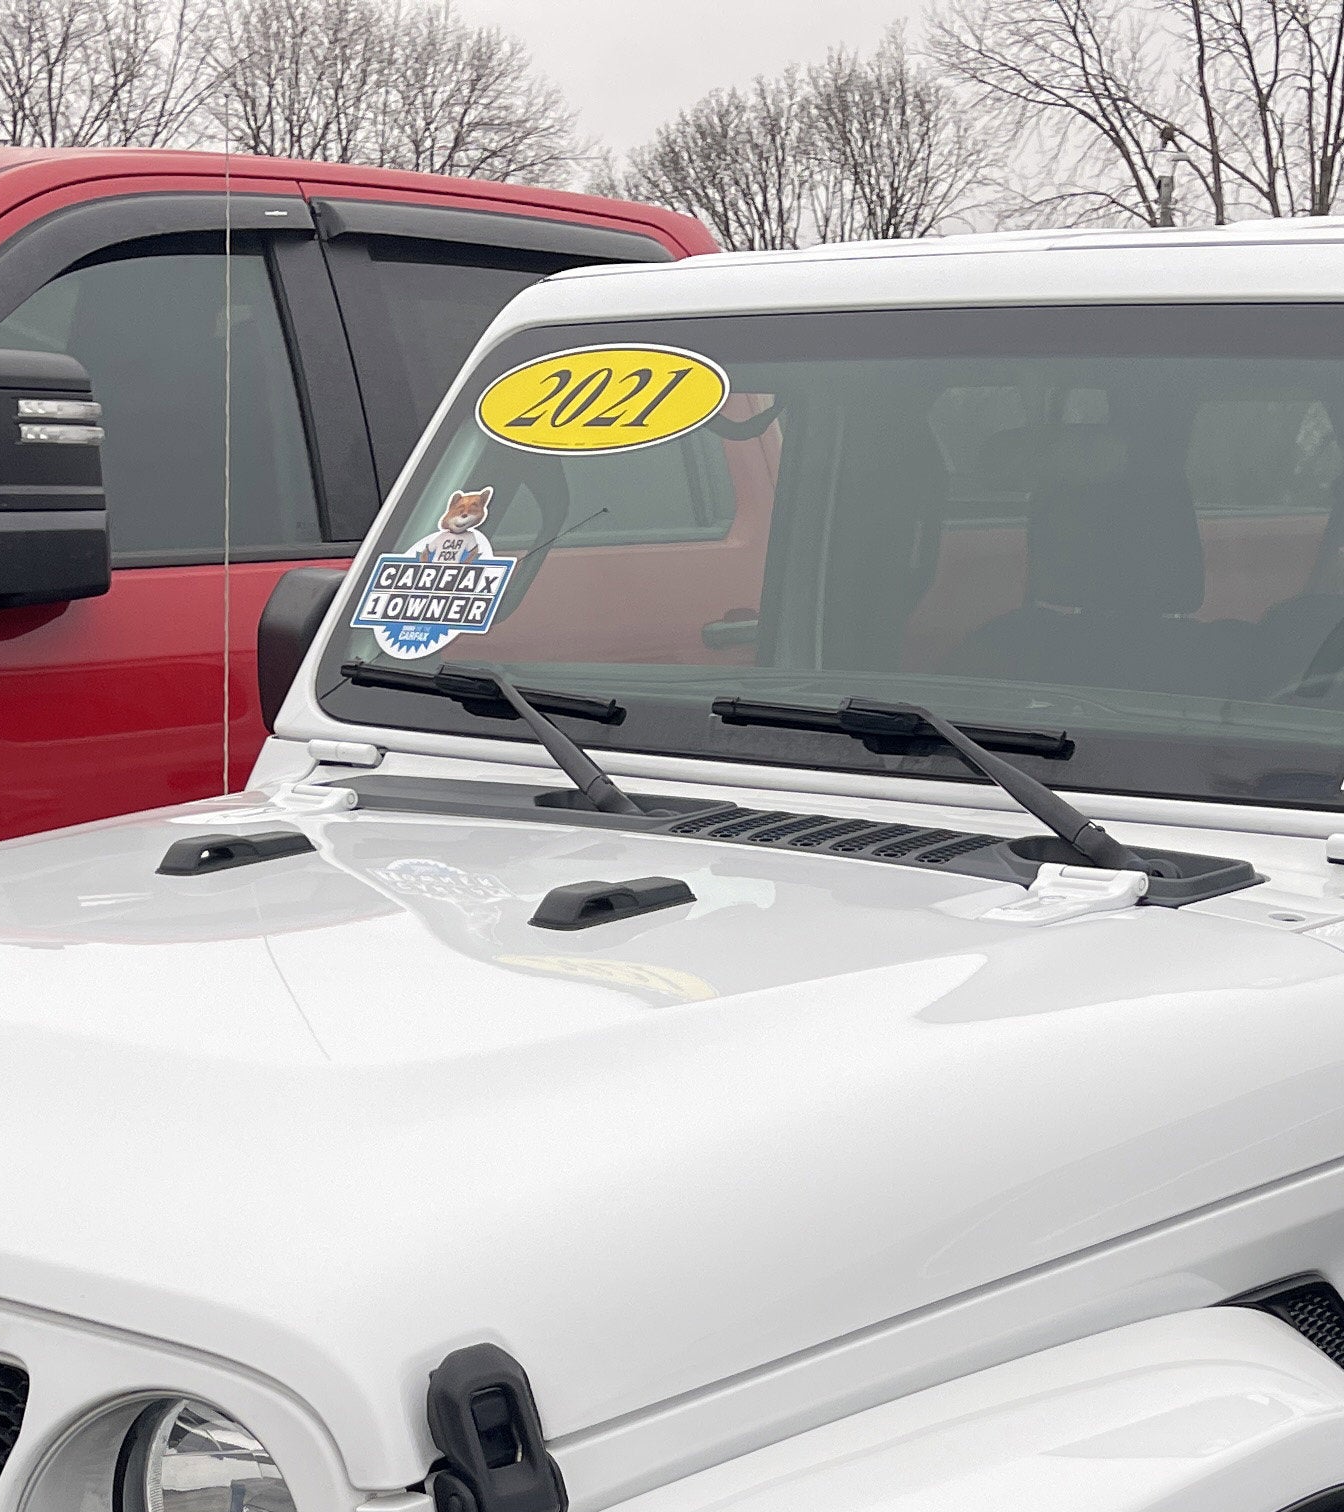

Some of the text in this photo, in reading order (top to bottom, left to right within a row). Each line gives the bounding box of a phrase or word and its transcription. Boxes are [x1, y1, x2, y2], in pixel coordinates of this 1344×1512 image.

[504, 367, 694, 428] 2021
[442, 539, 463, 550] CAR
[437, 551, 458, 562] FOX
[379, 566, 499, 594] CARFAX
[367, 595, 487, 621] 1 OWNER
[398, 631, 430, 642] CARFAX
